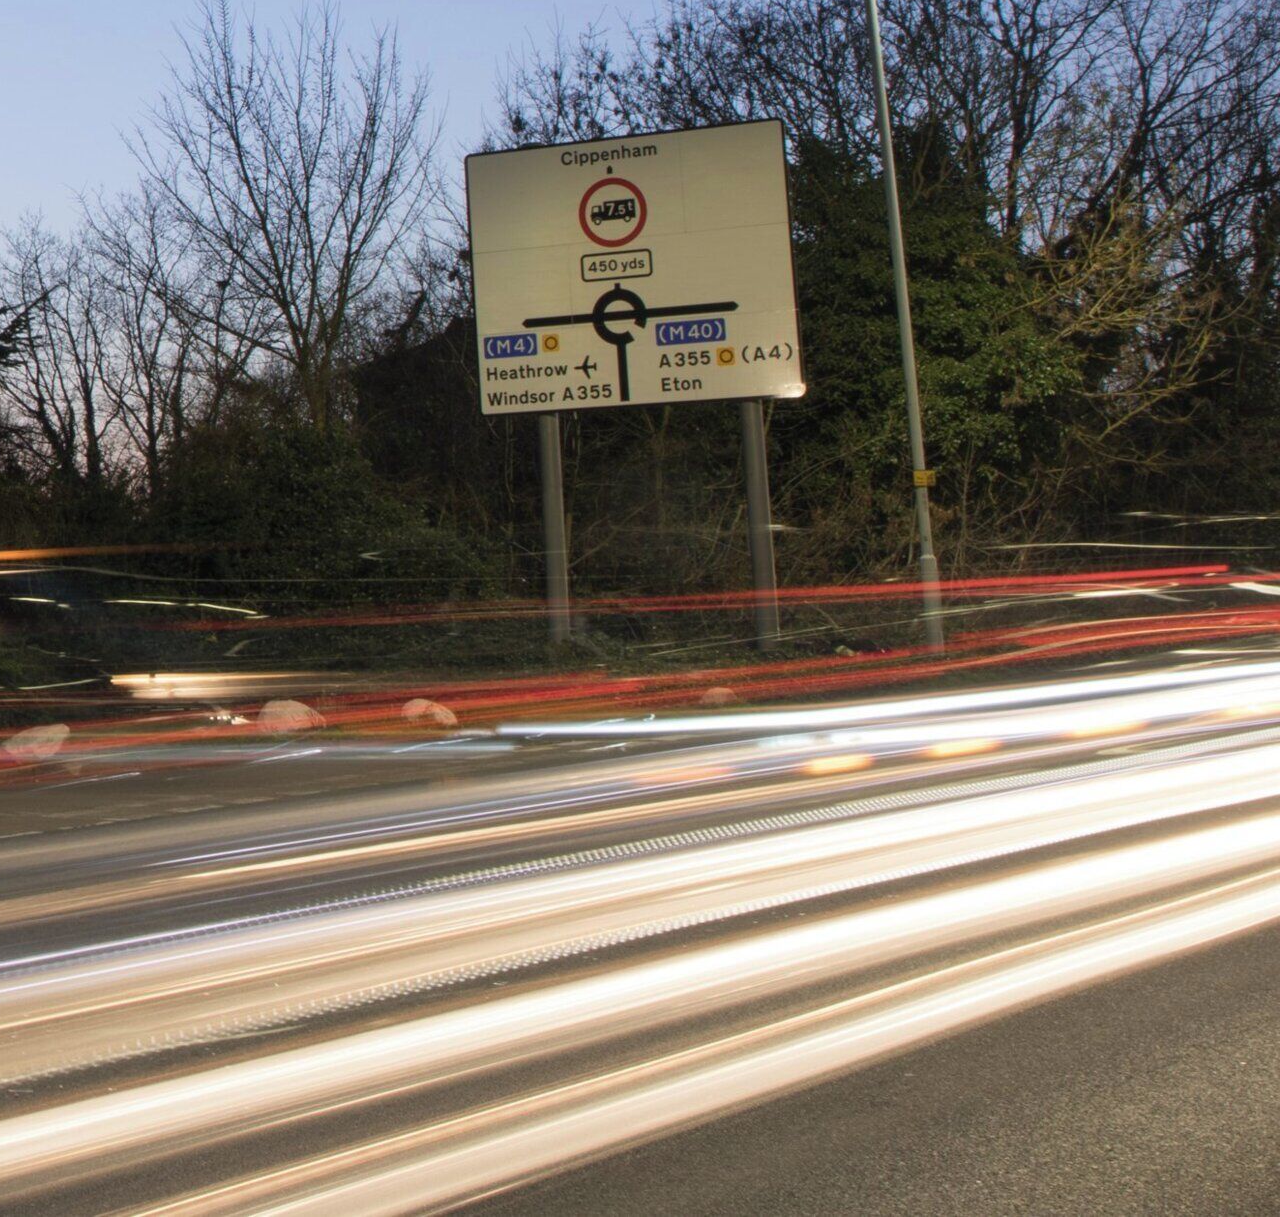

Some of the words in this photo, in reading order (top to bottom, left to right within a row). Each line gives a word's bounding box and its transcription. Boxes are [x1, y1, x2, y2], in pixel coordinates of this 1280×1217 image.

[560, 143, 658, 167] Cippenham
[588, 258, 618, 273] 450
[621, 256, 645, 274] yds
[486, 335, 535, 357] (M4)
[659, 350, 711, 369] A355
[741, 342, 793, 364] (A4)
[486, 364, 568, 382] Heathrow
[487, 389, 555, 407] Windsor
[562, 383, 613, 401] A355
[660, 377, 703, 392] Eton
